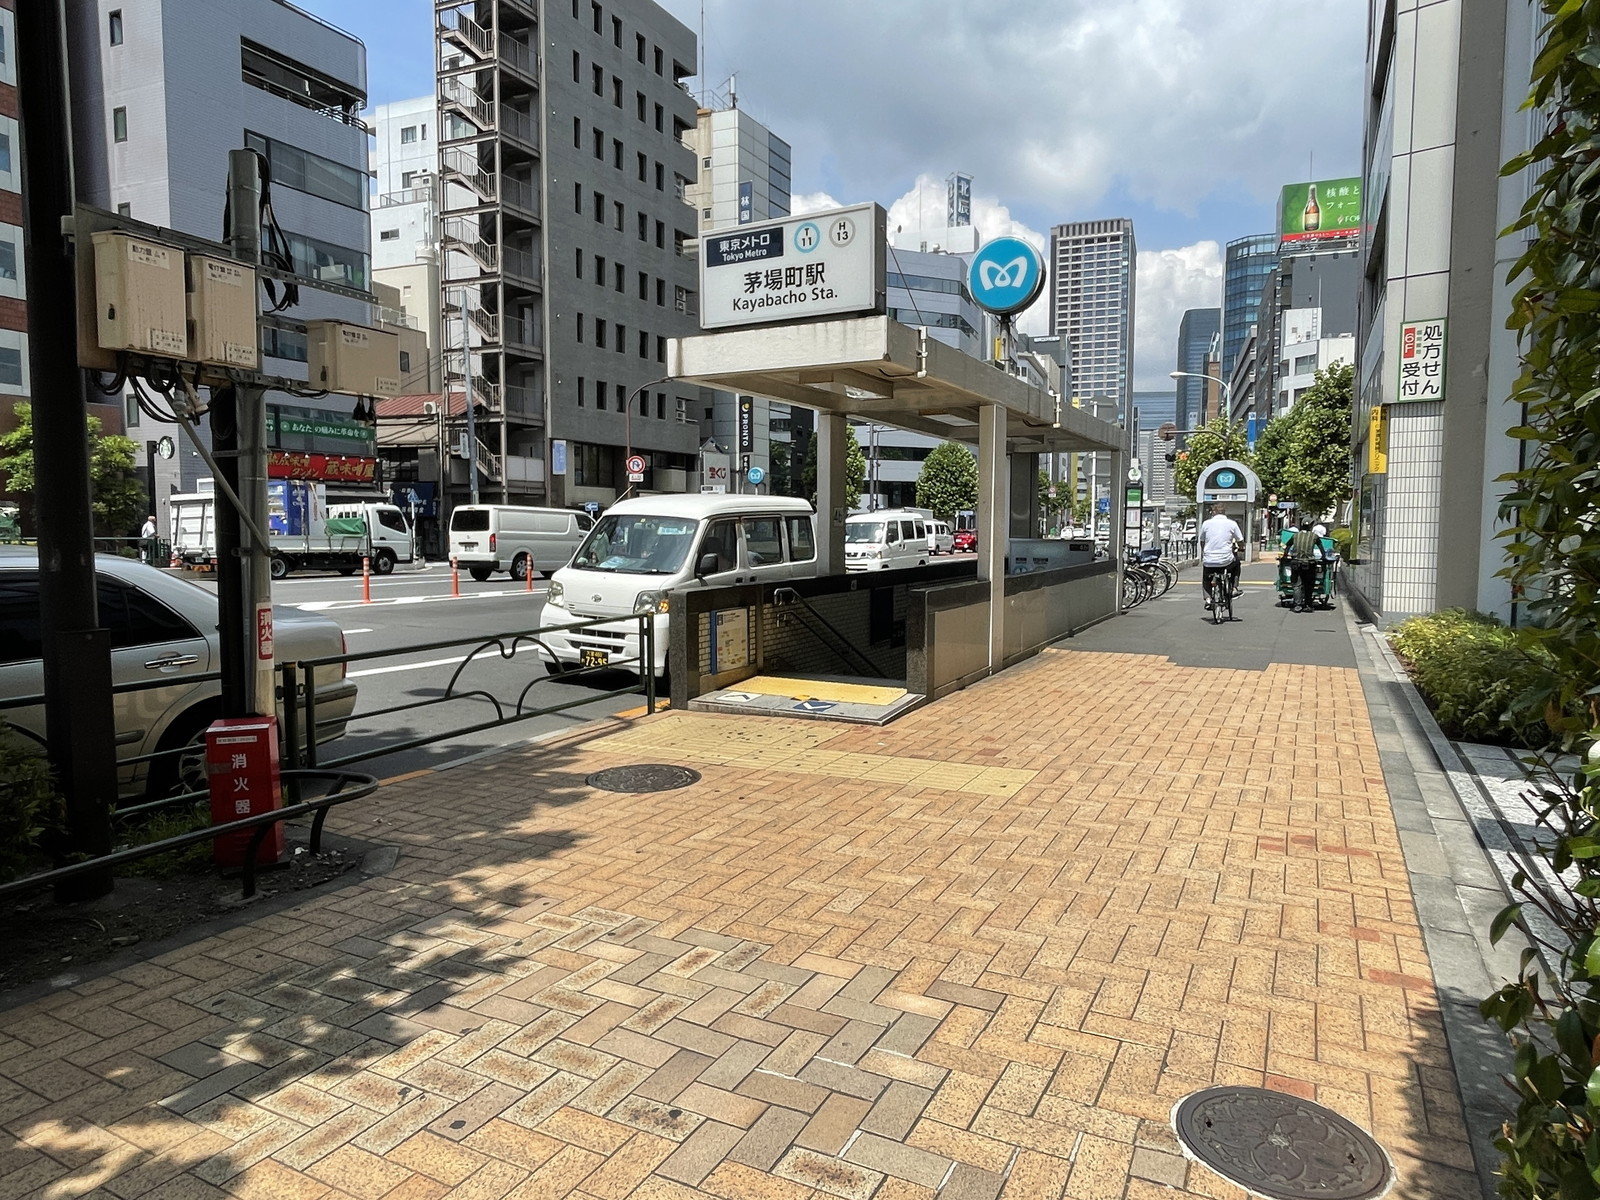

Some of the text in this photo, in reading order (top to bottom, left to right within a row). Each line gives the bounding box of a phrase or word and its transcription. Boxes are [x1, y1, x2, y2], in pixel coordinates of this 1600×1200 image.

[804, 228, 810, 237] T
[836, 231, 849, 242] 13
[838, 221, 846, 231] H
[719, 233, 771, 253] 東京メトロ
[801, 237, 813, 248] 11
[722, 248, 768, 262] Tokyo Metro
[743, 262, 826, 295] 茅場町駅
[732, 287, 838, 312] Kayabacho Sta.
[1404, 333, 1414, 354] 6F
[1421, 324, 1443, 396] 処方せん
[1401, 361, 1420, 396] 受付
[259, 611, 273, 656] 消火器
[231, 753, 251, 815] 消火器
